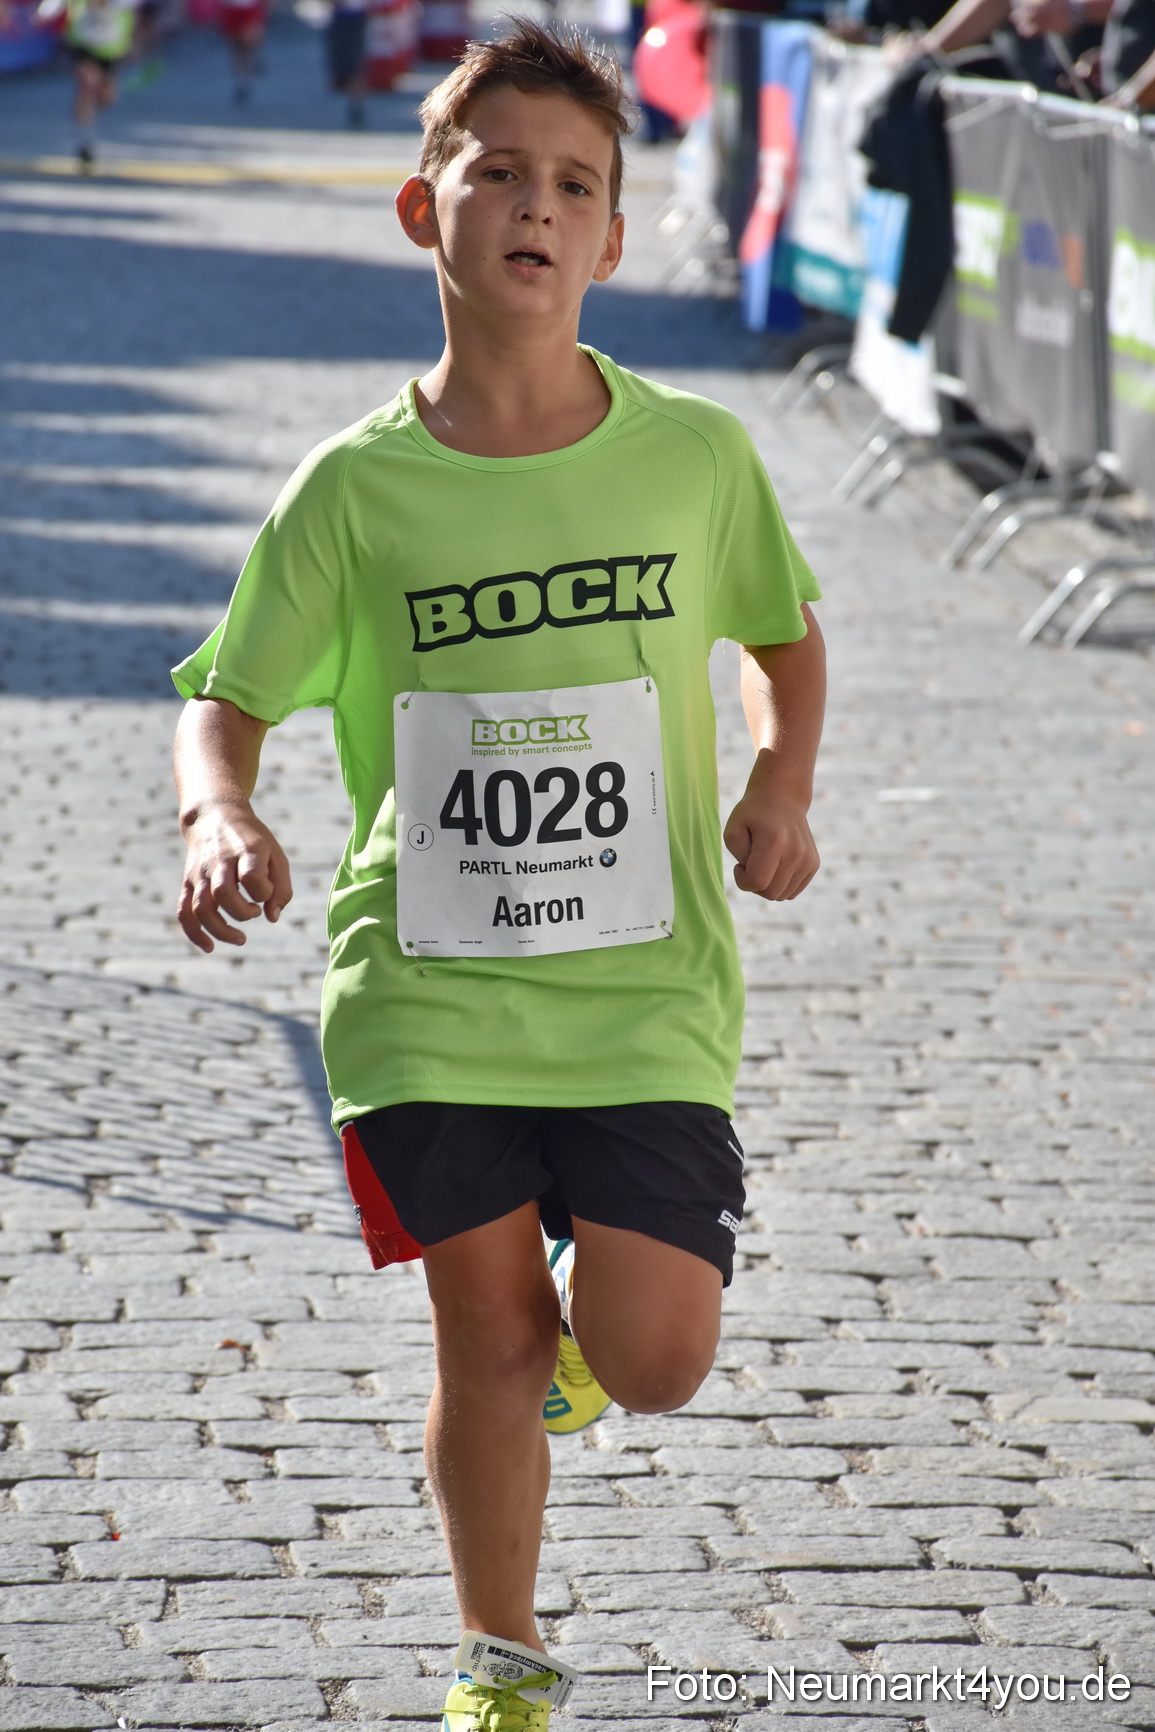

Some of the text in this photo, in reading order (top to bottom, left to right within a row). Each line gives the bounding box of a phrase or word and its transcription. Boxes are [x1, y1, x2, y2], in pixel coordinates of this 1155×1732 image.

[404, 553, 677, 652] BOCK
[472, 714, 591, 746] BOCK
[471, 742, 593, 757] inspired by smart concepts
[439, 761, 629, 848] 4028
[416, 830, 425, 845] J
[459, 860, 512, 875] PARTL
[516, 855, 594, 874] Neumarkt
[492, 896, 584, 928] Aaron
